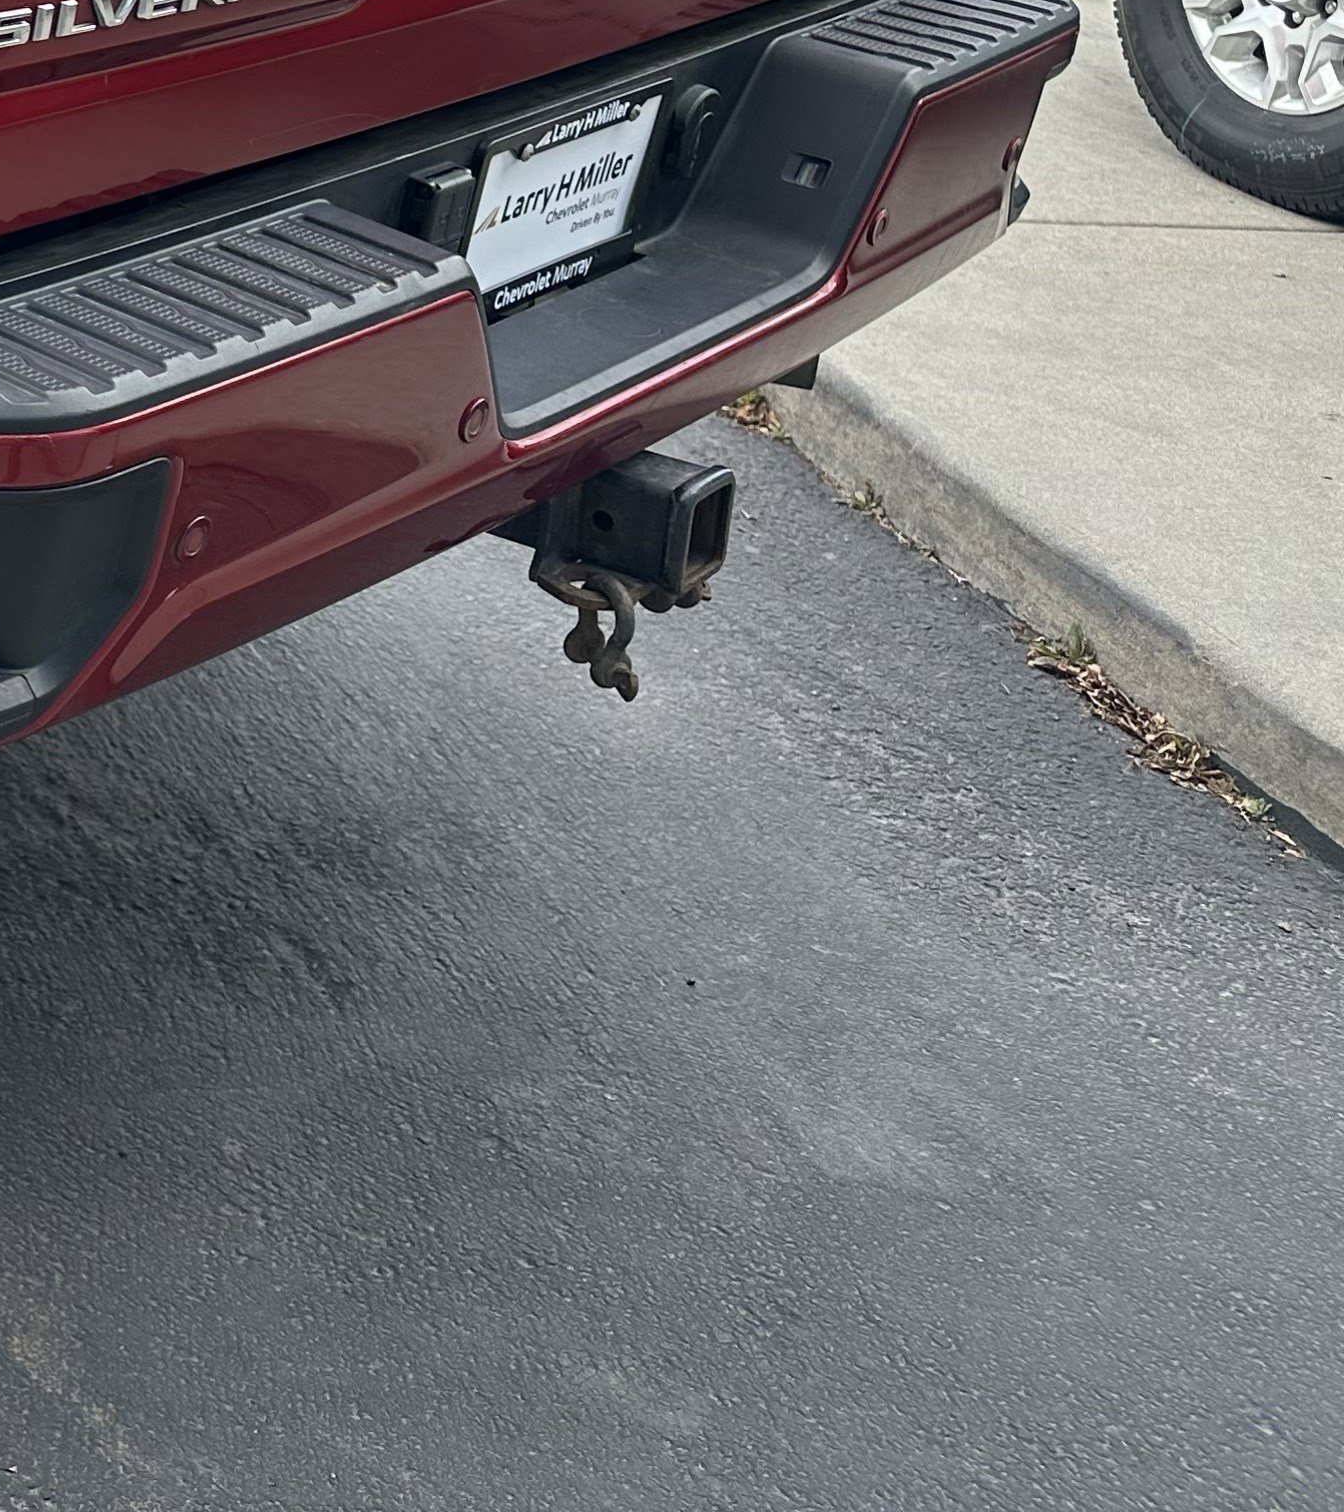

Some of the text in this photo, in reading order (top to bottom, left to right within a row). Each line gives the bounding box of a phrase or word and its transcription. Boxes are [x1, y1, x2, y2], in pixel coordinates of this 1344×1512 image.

[551, 99, 631, 143] Larry H Miller
[500, 151, 634, 224] Larry H Miller
[545, 187, 622, 225] Chevrolet Murray
[494, 256, 593, 310] Chevrolet Murray
